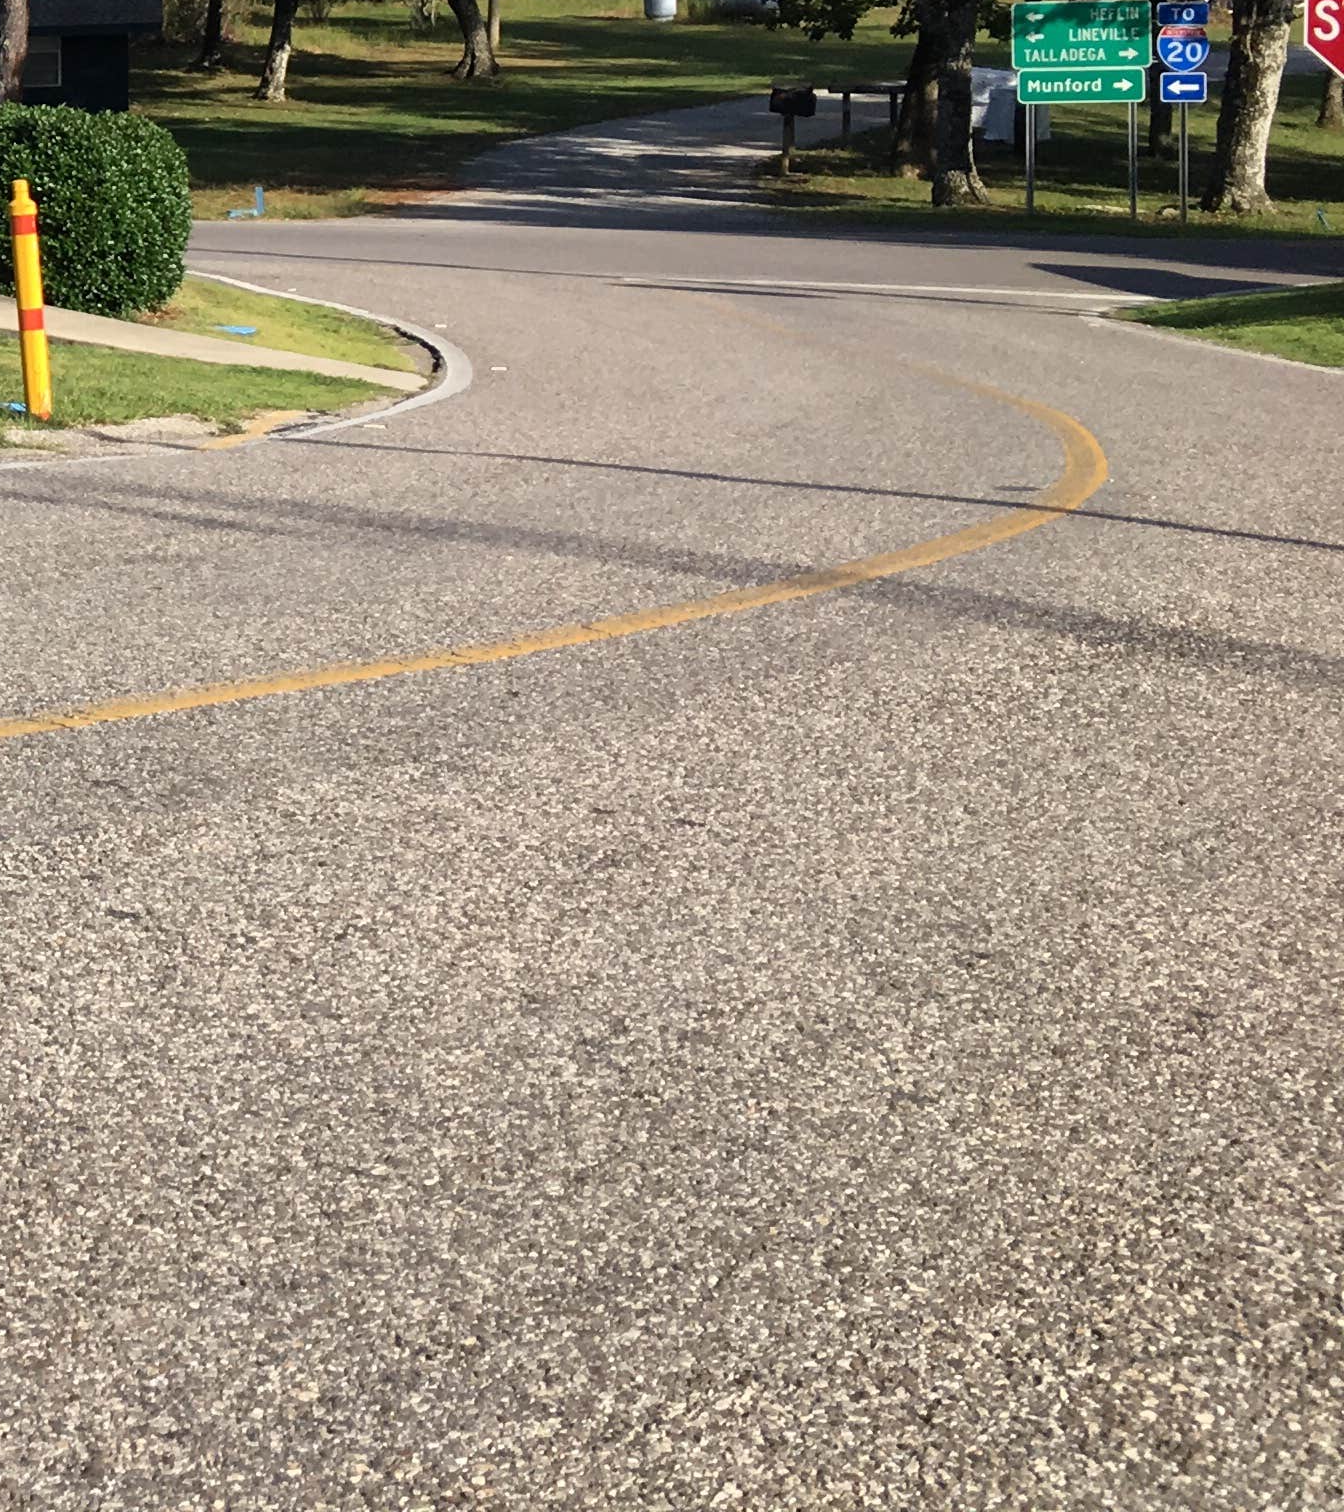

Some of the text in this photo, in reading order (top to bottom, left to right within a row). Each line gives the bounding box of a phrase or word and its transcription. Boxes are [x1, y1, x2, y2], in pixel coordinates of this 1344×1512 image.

[1090, 7, 1140, 21] HEFLIN
[1171, 8, 1195, 21] TO
[1069, 27, 1140, 42] LINEVILLE
[1024, 48, 1107, 63] TALLADEGA
[1167, 41, 1203, 63] 20
[1027, 78, 1102, 93] Munford
